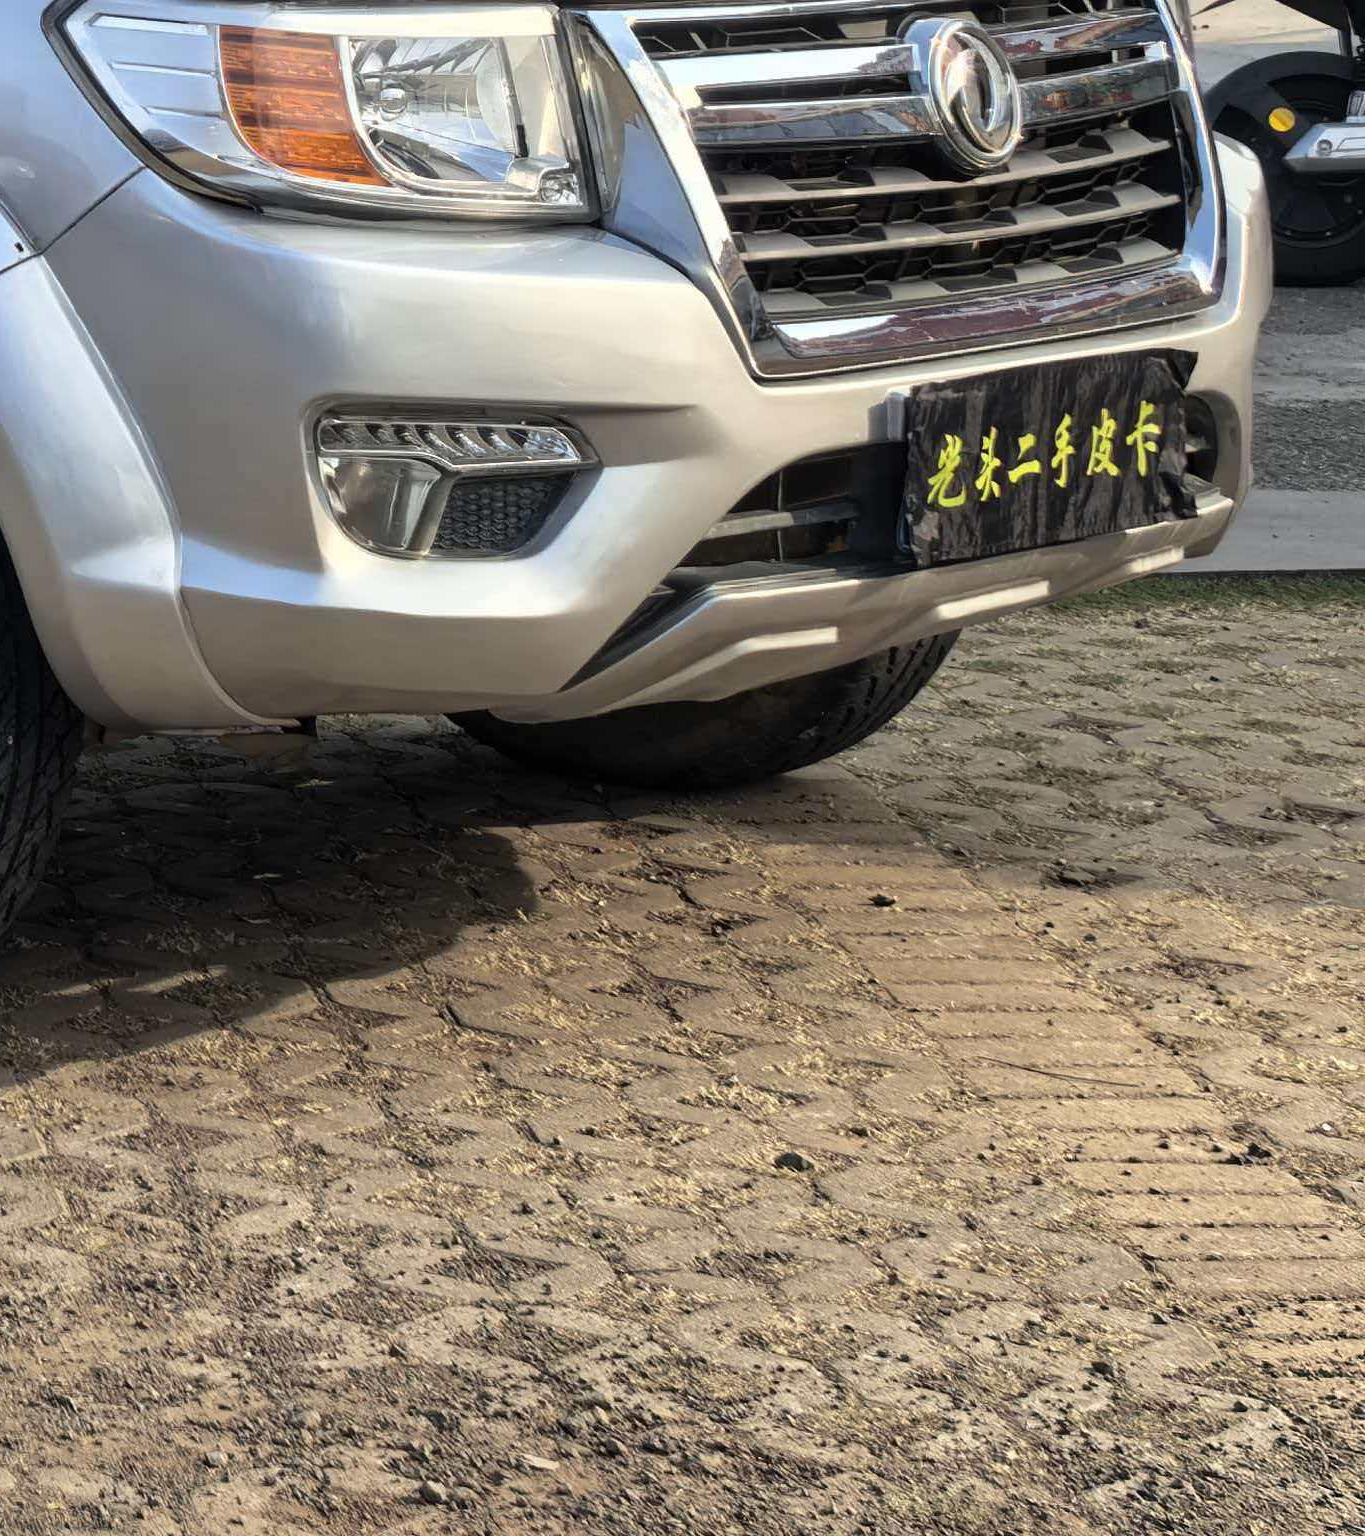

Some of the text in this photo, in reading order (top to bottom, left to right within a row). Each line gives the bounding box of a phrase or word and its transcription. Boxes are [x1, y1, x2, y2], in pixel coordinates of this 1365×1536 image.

[927, 400, 1161, 508] 光头二手皮卡
